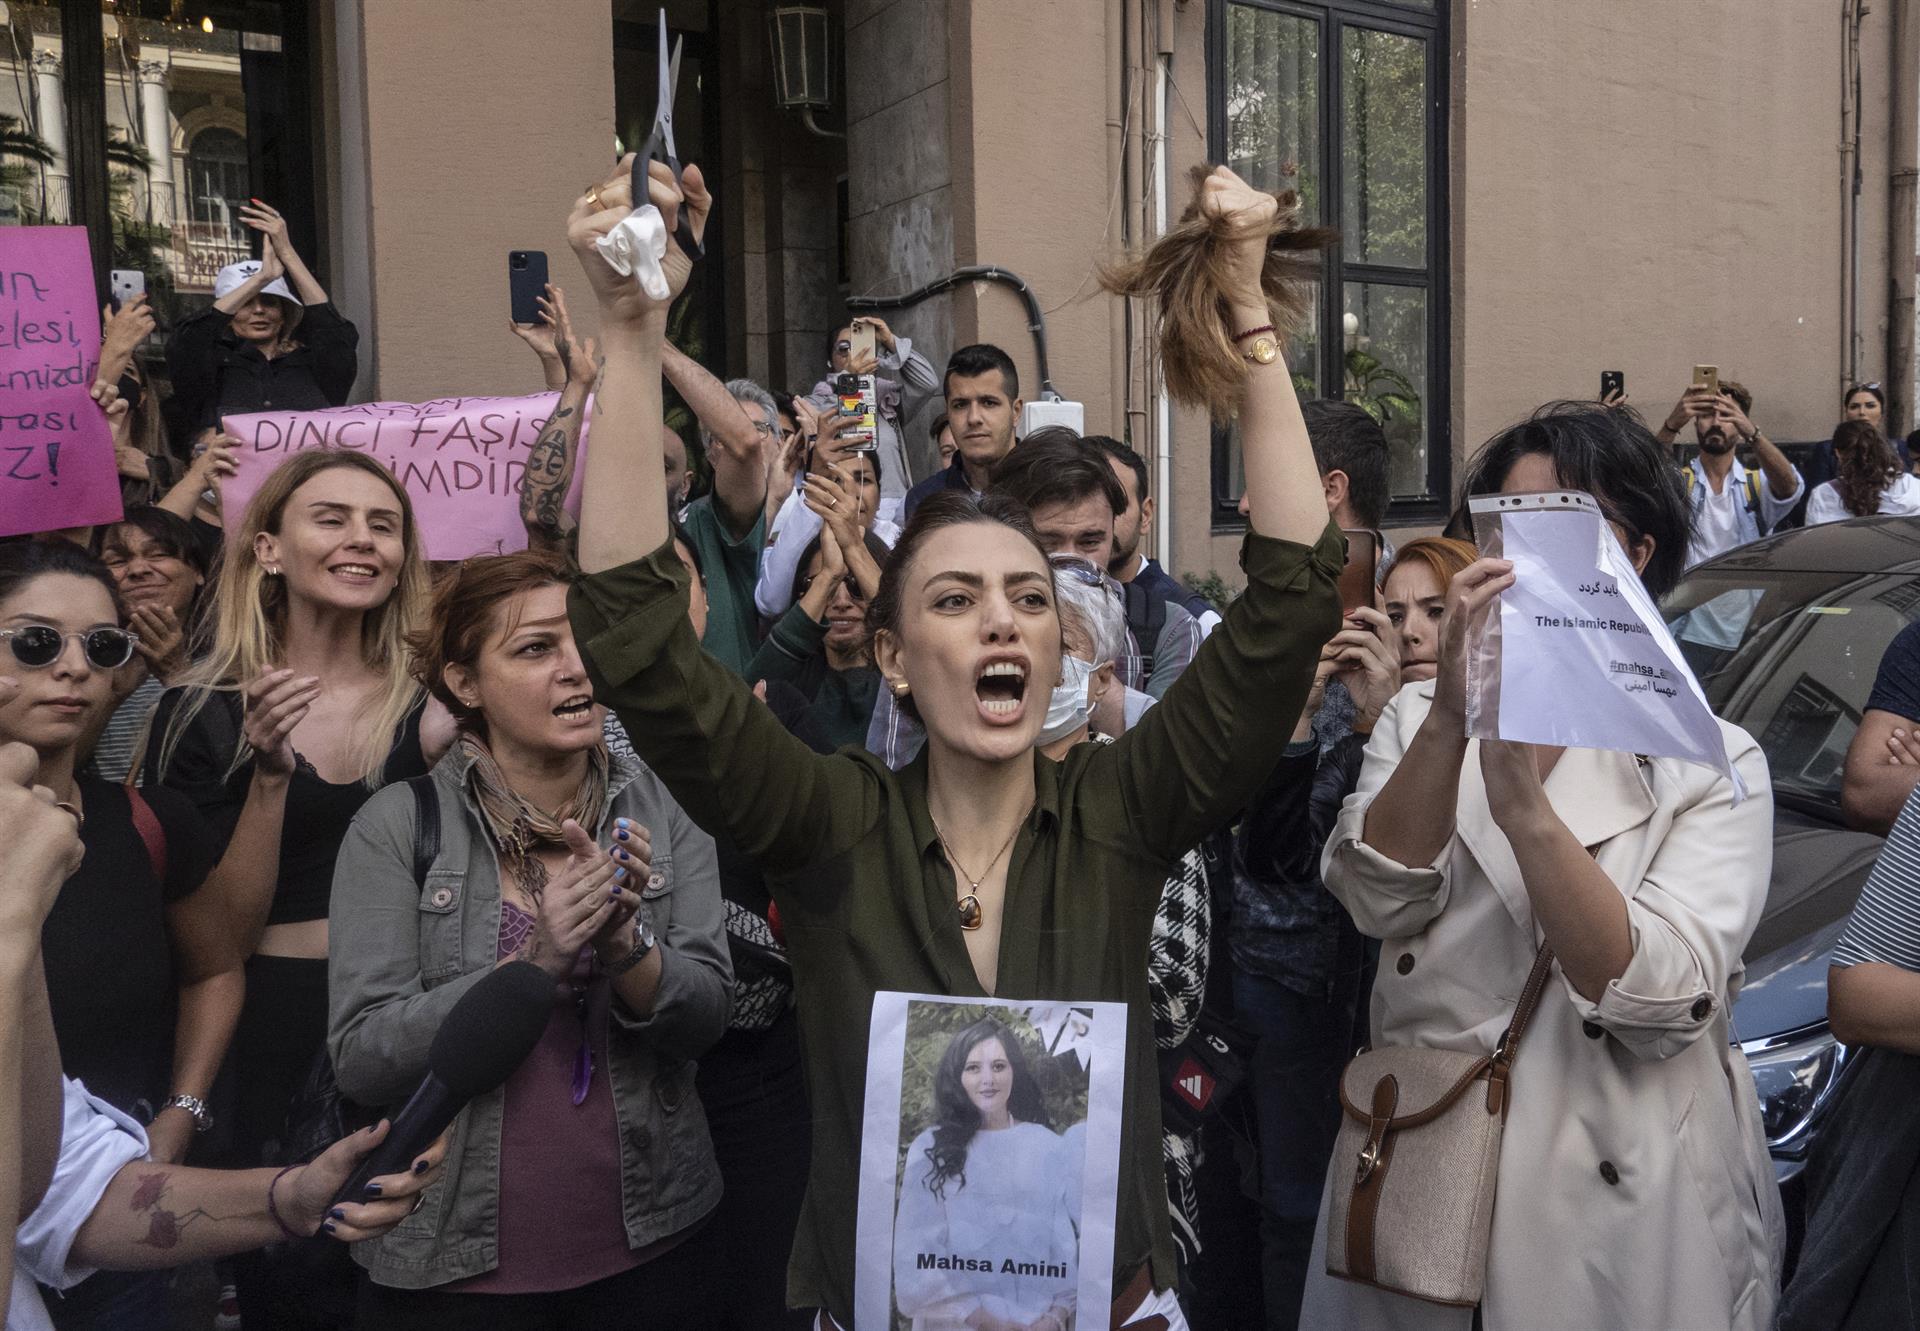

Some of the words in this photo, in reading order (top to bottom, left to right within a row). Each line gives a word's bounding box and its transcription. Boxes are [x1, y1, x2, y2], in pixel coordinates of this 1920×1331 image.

[0, 350, 98, 390] mizdir
[1535, 616, 1560, 628] The
[1563, 617, 1607, 630] Islamic
[1653, 681, 1677, 698] مهسا
[916, 1253, 993, 1273] Mahsa
[1000, 1258, 1067, 1279] Amini
